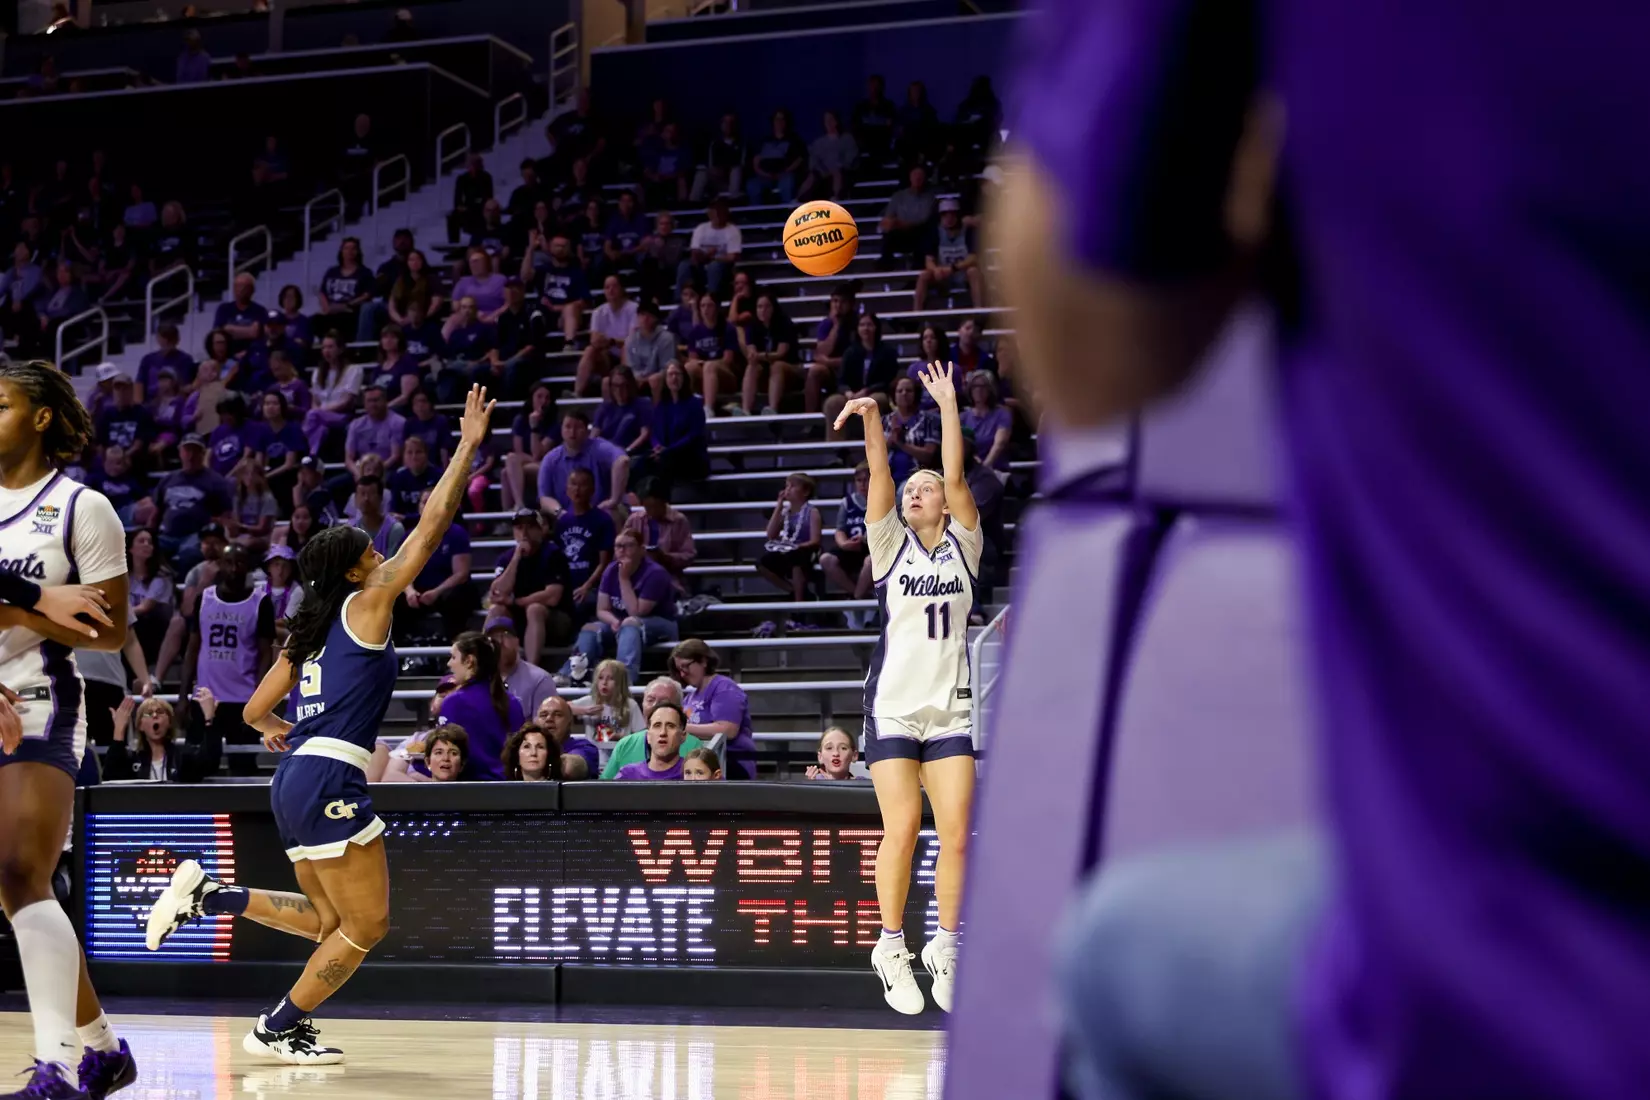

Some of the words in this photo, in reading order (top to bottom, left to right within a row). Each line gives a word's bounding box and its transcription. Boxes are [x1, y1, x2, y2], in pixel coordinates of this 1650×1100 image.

[795, 210, 831, 227] NCAA
[794, 228, 844, 247] Wilson
[924, 602, 952, 640] 11
[209, 624, 238, 648] 26
[208, 650, 236, 661] STATE
[300, 660, 322, 698] 5
[324, 799, 359, 820] GT
[494, 887, 716, 962] ELEVATE
[737, 899, 884, 946] THE
